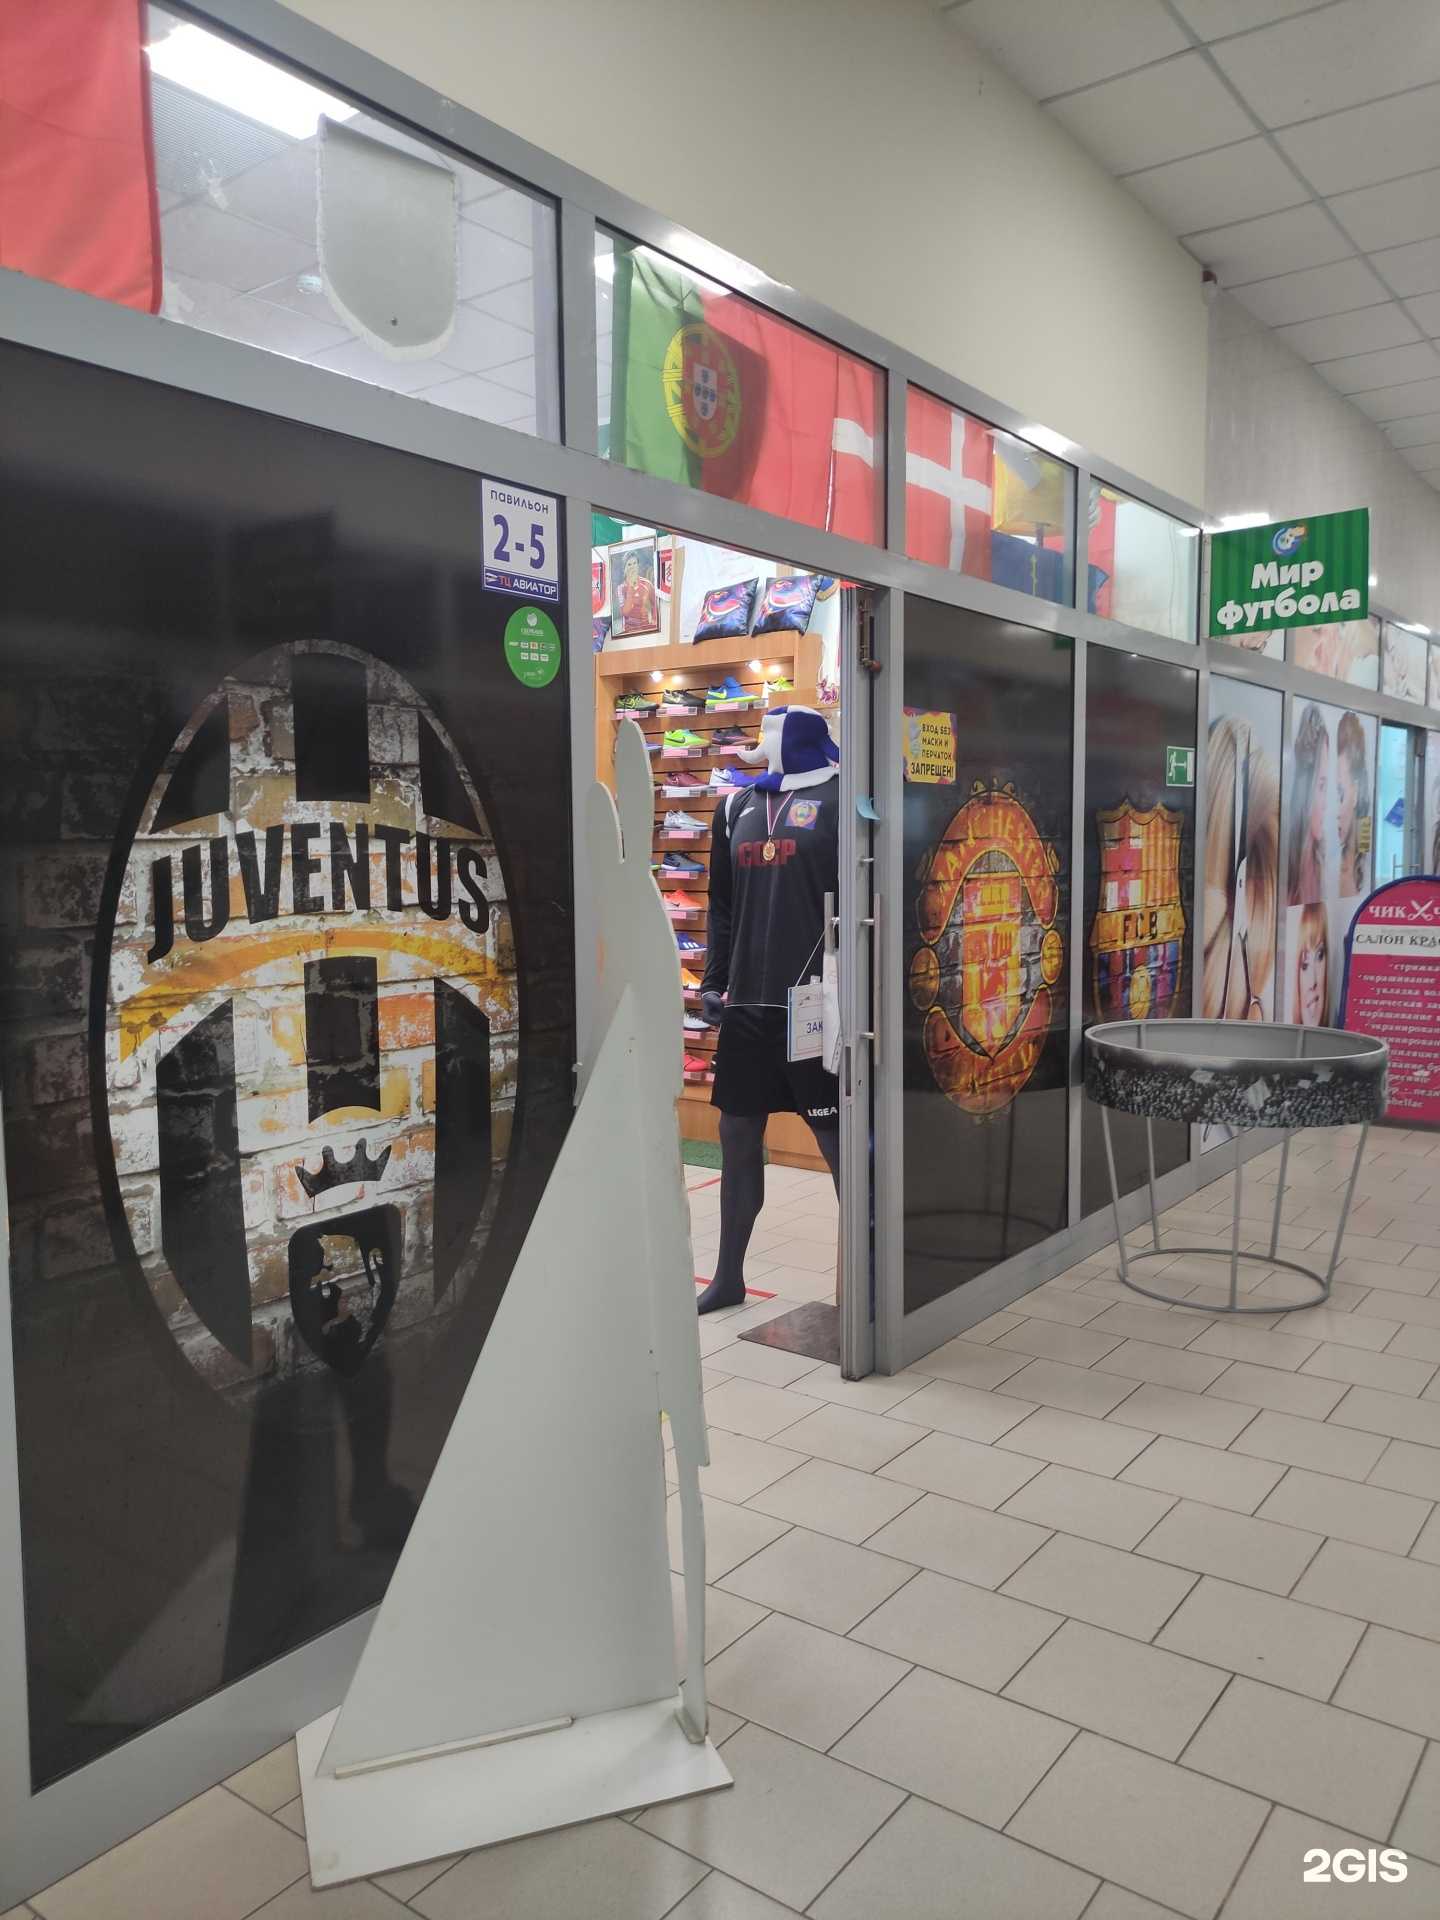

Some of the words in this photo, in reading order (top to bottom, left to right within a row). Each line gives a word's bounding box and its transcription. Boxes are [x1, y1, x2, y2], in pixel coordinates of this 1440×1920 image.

[493, 514, 545, 569] 2-5
[1251, 560, 1324, 589] Мир
[498, 575, 512, 588] ТЦ
[513, 578, 556, 596] АВИАТОР
[1217, 587, 1360, 630] футбола
[921, 723, 938, 735] ВХОД
[940, 726, 951, 736] БЕЗ
[922, 737, 943, 747] МАСКИ
[944, 740, 949, 748] И
[921, 749, 952, 760] ПЕРЧАТОК
[147, 822, 491, 965] JUVENTUS
[1369, 905, 1407, 918] ЧИК
[1356, 934, 1404, 945] САЛОН
[1409, 935, 1440, 947] КРА
[808, 1106, 838, 1117] LEGEA
